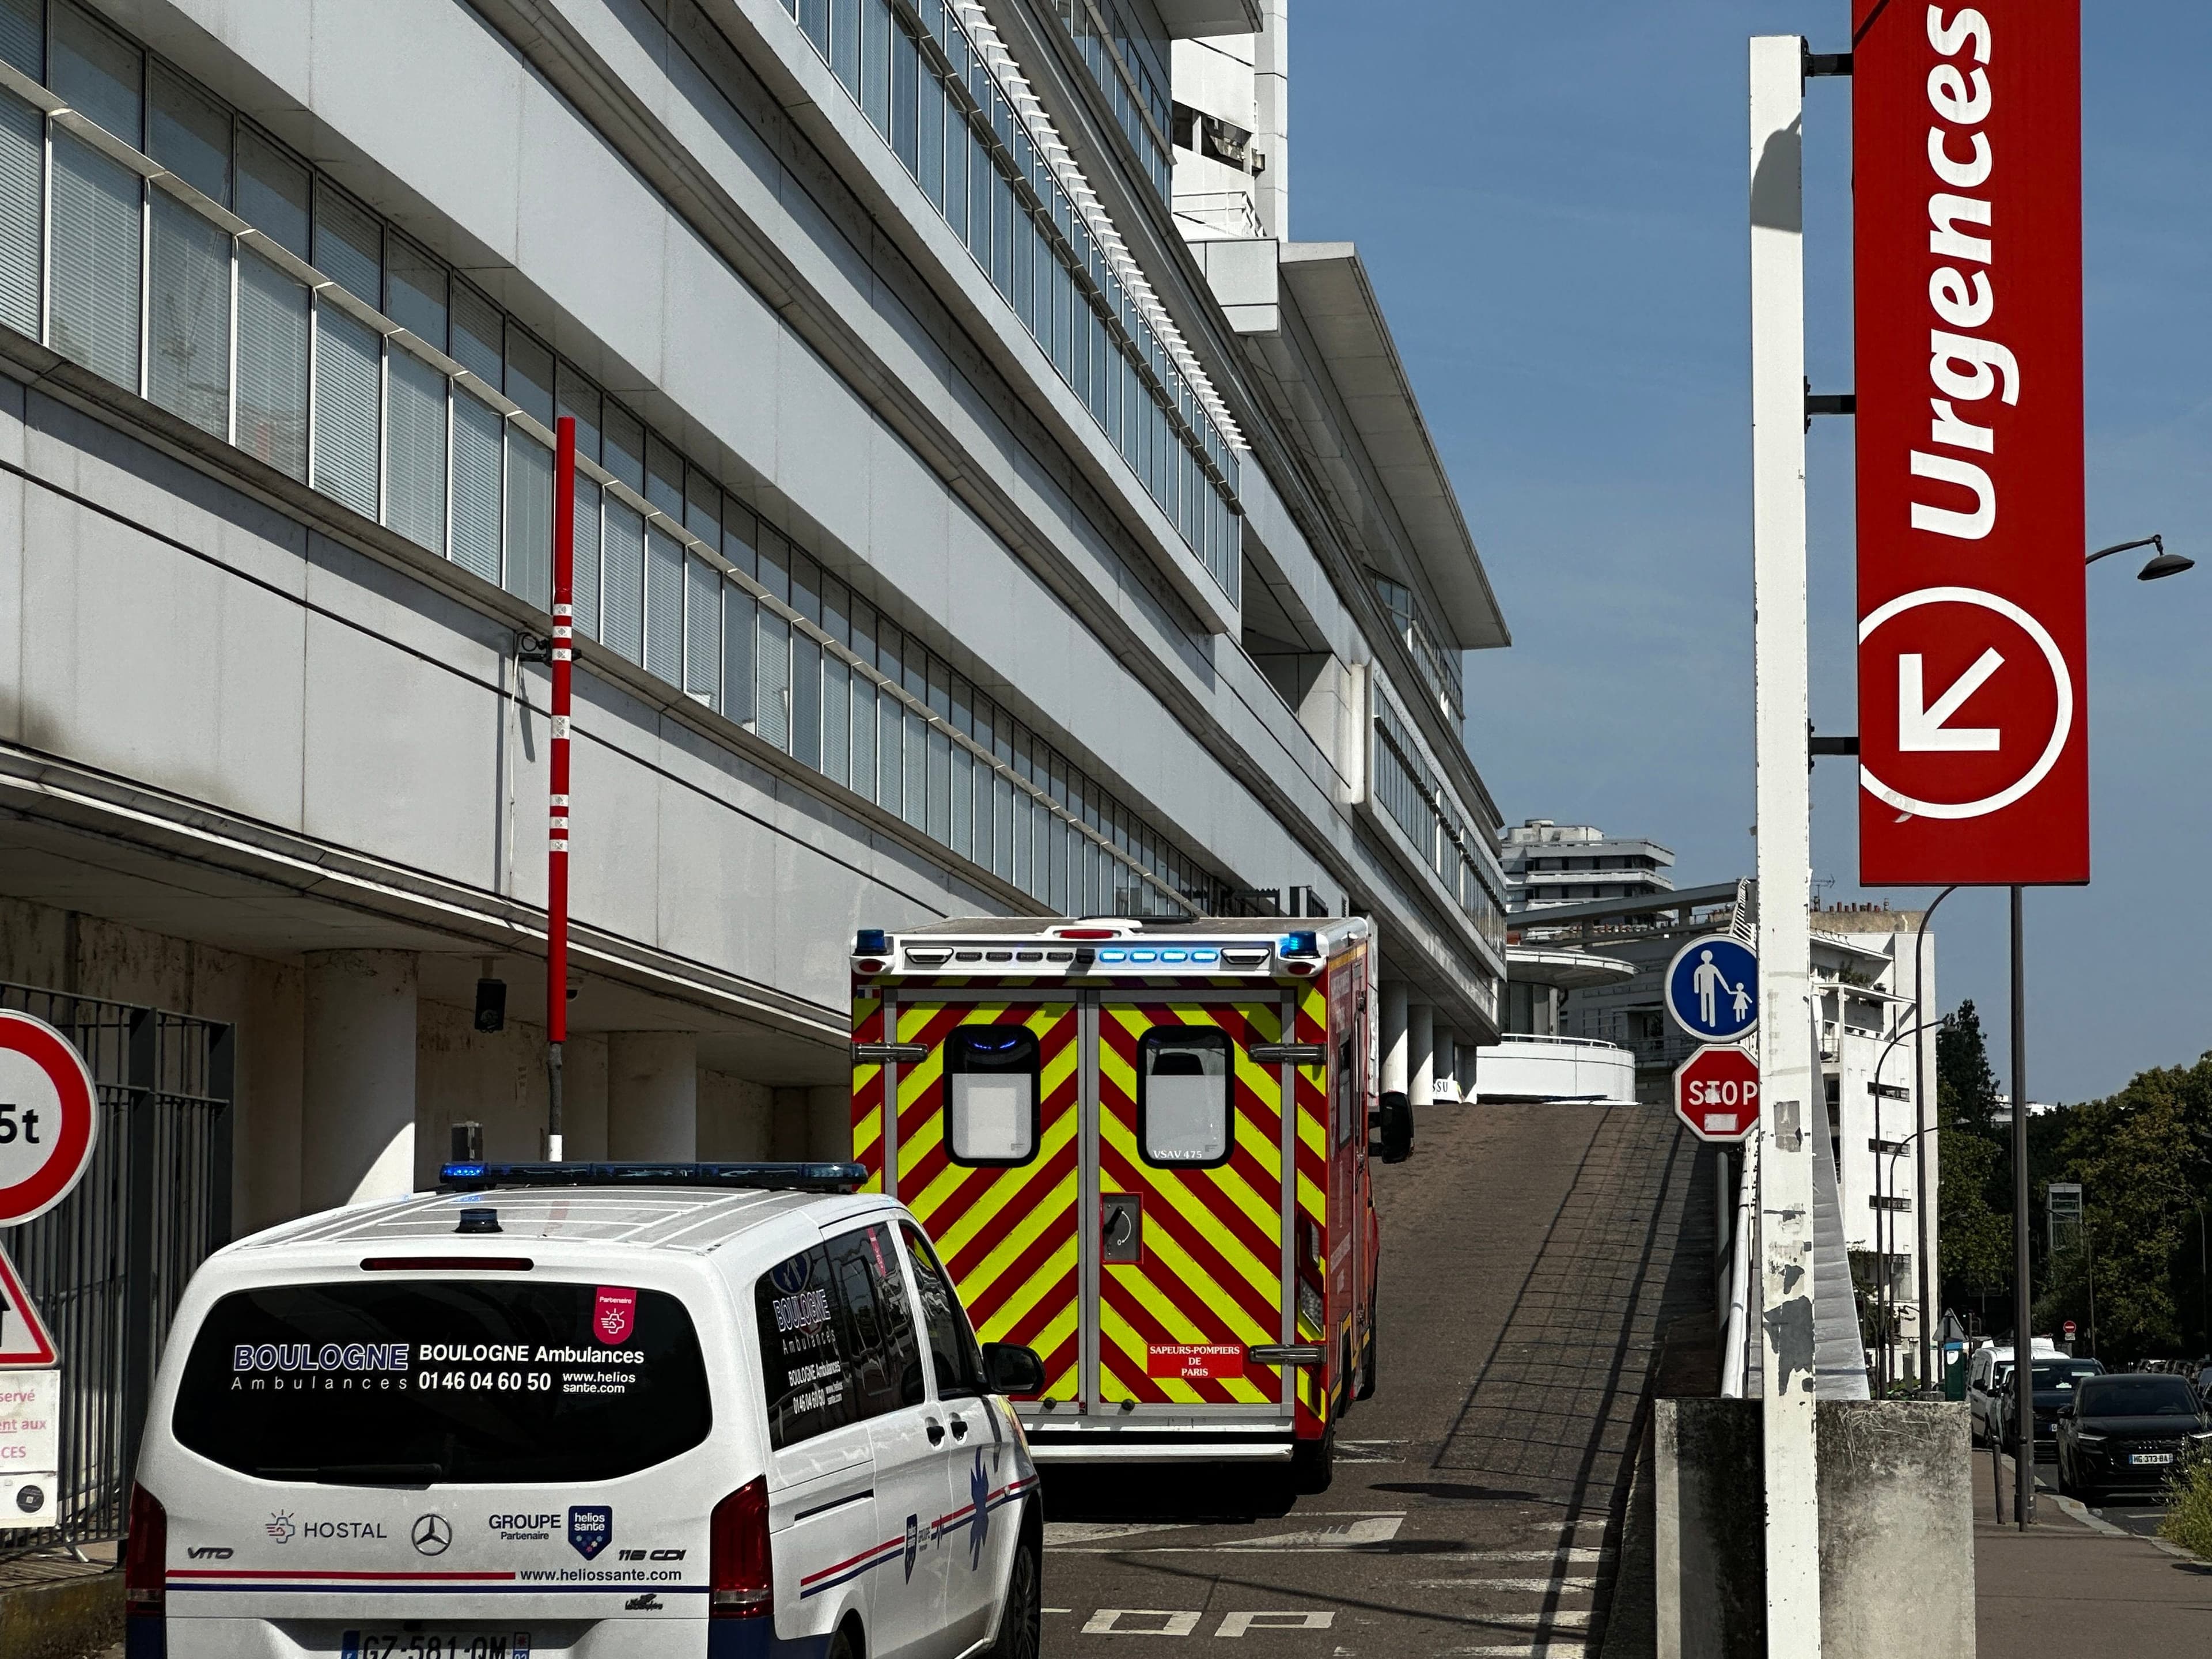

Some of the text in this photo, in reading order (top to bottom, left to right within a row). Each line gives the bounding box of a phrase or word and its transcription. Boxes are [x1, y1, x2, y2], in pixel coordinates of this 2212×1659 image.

[1911, 4, 2020, 539] Urgences
[1688, 1081, 1758, 1105] STOP
[0, 1104, 40, 1144] 5t
[1153, 1150, 1202, 1159] VSAV 475
[599, 1296, 632, 1304] Partenaire
[772, 1289, 831, 1332] BOULOGNE
[782, 1329, 836, 1355] Ambulances
[419, 1344, 645, 1363] BOULOGNE Ambulances
[1150, 1346, 1240, 1354] SAPEURS-POMPIERS
[233, 1343, 410, 1371] BOULOGNE
[1188, 1357, 1202, 1365] DE
[562, 1371, 636, 1382] www.helios
[1181, 1368, 1209, 1376] PARIS
[231, 1376, 407, 1390] Ambulances
[419, 1372, 551, 1391] 01 46 04 60 50
[562, 1383, 625, 1393] sante.com
[0, 1419, 46, 1430] nt aux
[488, 1514, 562, 1529] GROUPE
[574, 1512, 605, 1522] helios
[304, 1522, 387, 1538] HOSTAL
[574, 1522, 605, 1531] sante
[501, 1531, 550, 1540] Partenaire
[187, 1547, 234, 1559] VITO
[619, 1550, 687, 1561] 116 CDI
[520, 1569, 682, 1581] www.heliossante.com
